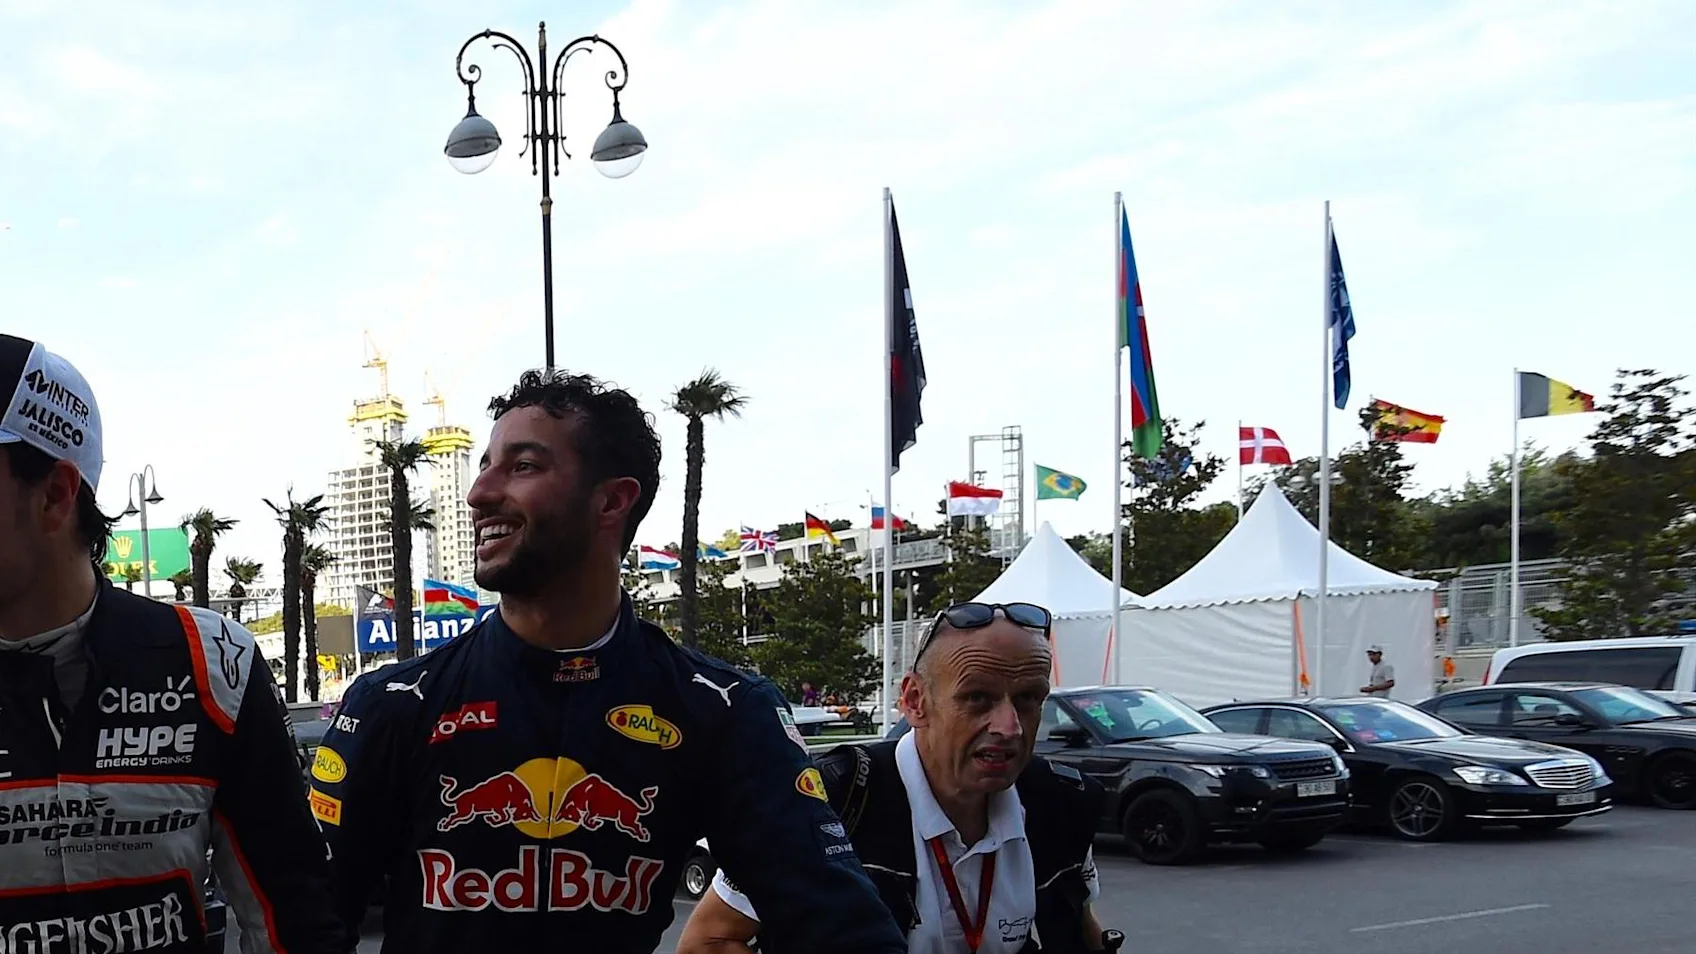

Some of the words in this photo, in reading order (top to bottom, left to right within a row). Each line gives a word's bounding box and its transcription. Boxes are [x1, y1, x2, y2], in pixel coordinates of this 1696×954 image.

[47, 380, 89, 421] INTER
[18, 398, 84, 447] JALISCO
[368, 616, 475, 644] Alianz
[98, 683, 189, 714] Claro
[96, 723, 198, 758] HYPE
[628, 714, 673, 744] RAUH
[96, 756, 147, 769] ENERGY
[151, 754, 193, 766] DRINKS
[45, 843, 93, 858] formula
[120, 840, 153, 852] team
[417, 846, 539, 912] Red
[548, 848, 664, 915] Bull
